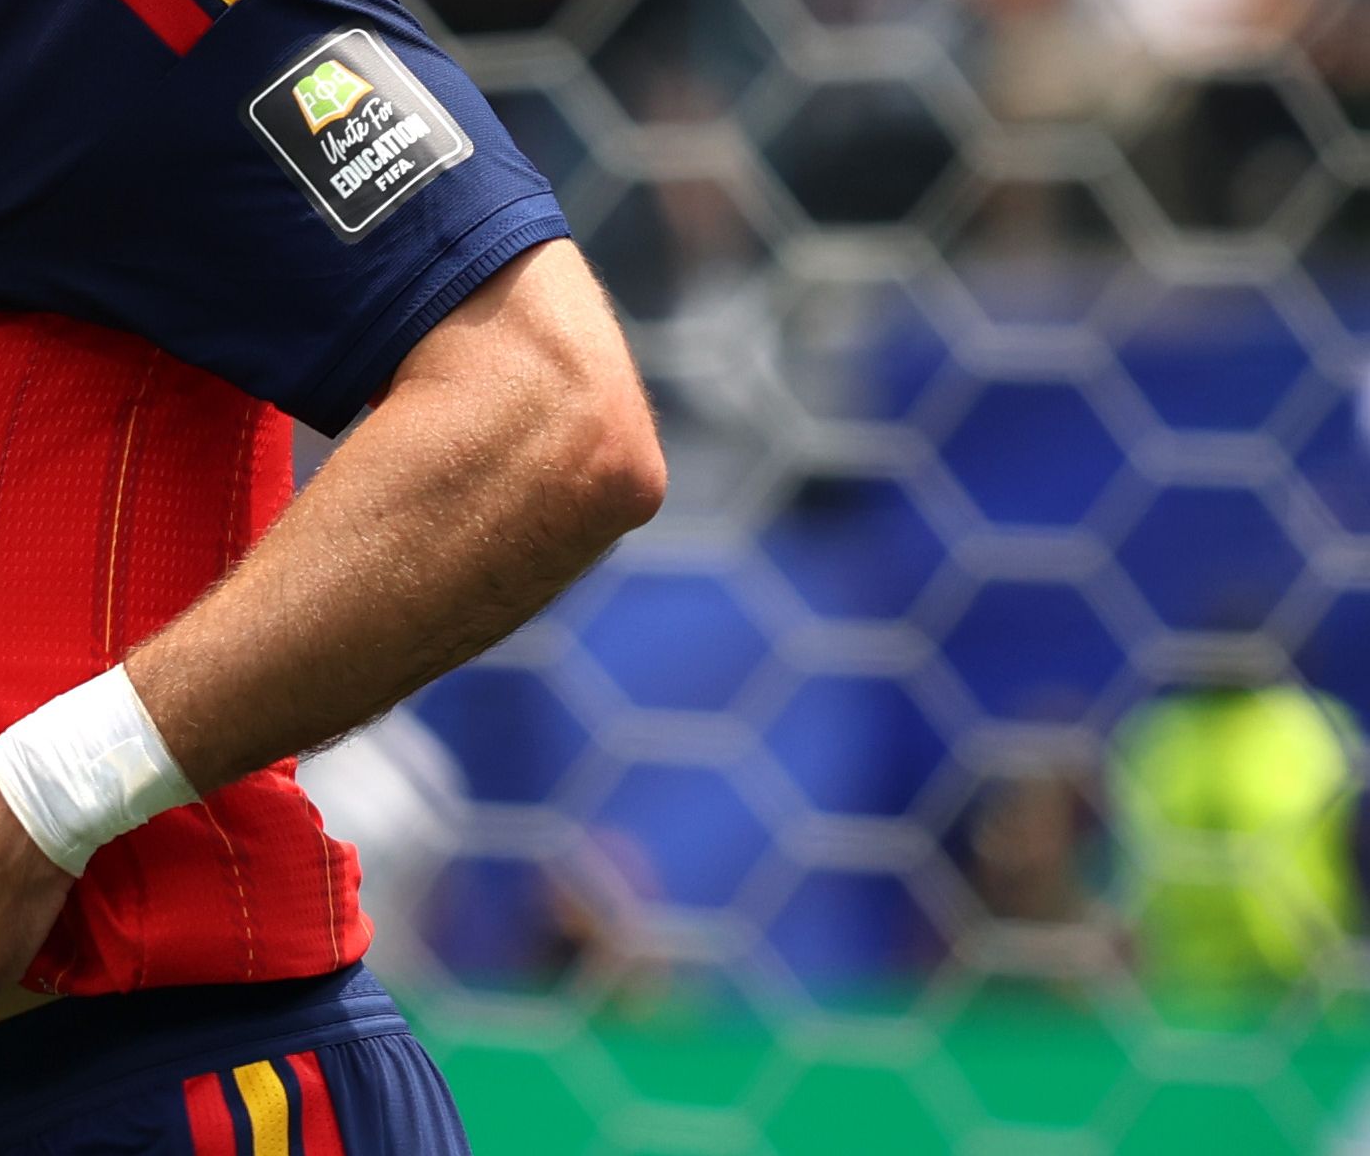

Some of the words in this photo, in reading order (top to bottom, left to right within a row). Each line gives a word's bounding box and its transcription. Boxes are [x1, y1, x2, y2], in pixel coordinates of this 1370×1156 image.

[320, 117, 370, 165] Unite
[362, 97, 393, 131] For
[329, 112, 431, 200] EDUCATION
[374, 159, 413, 192] FIFA
